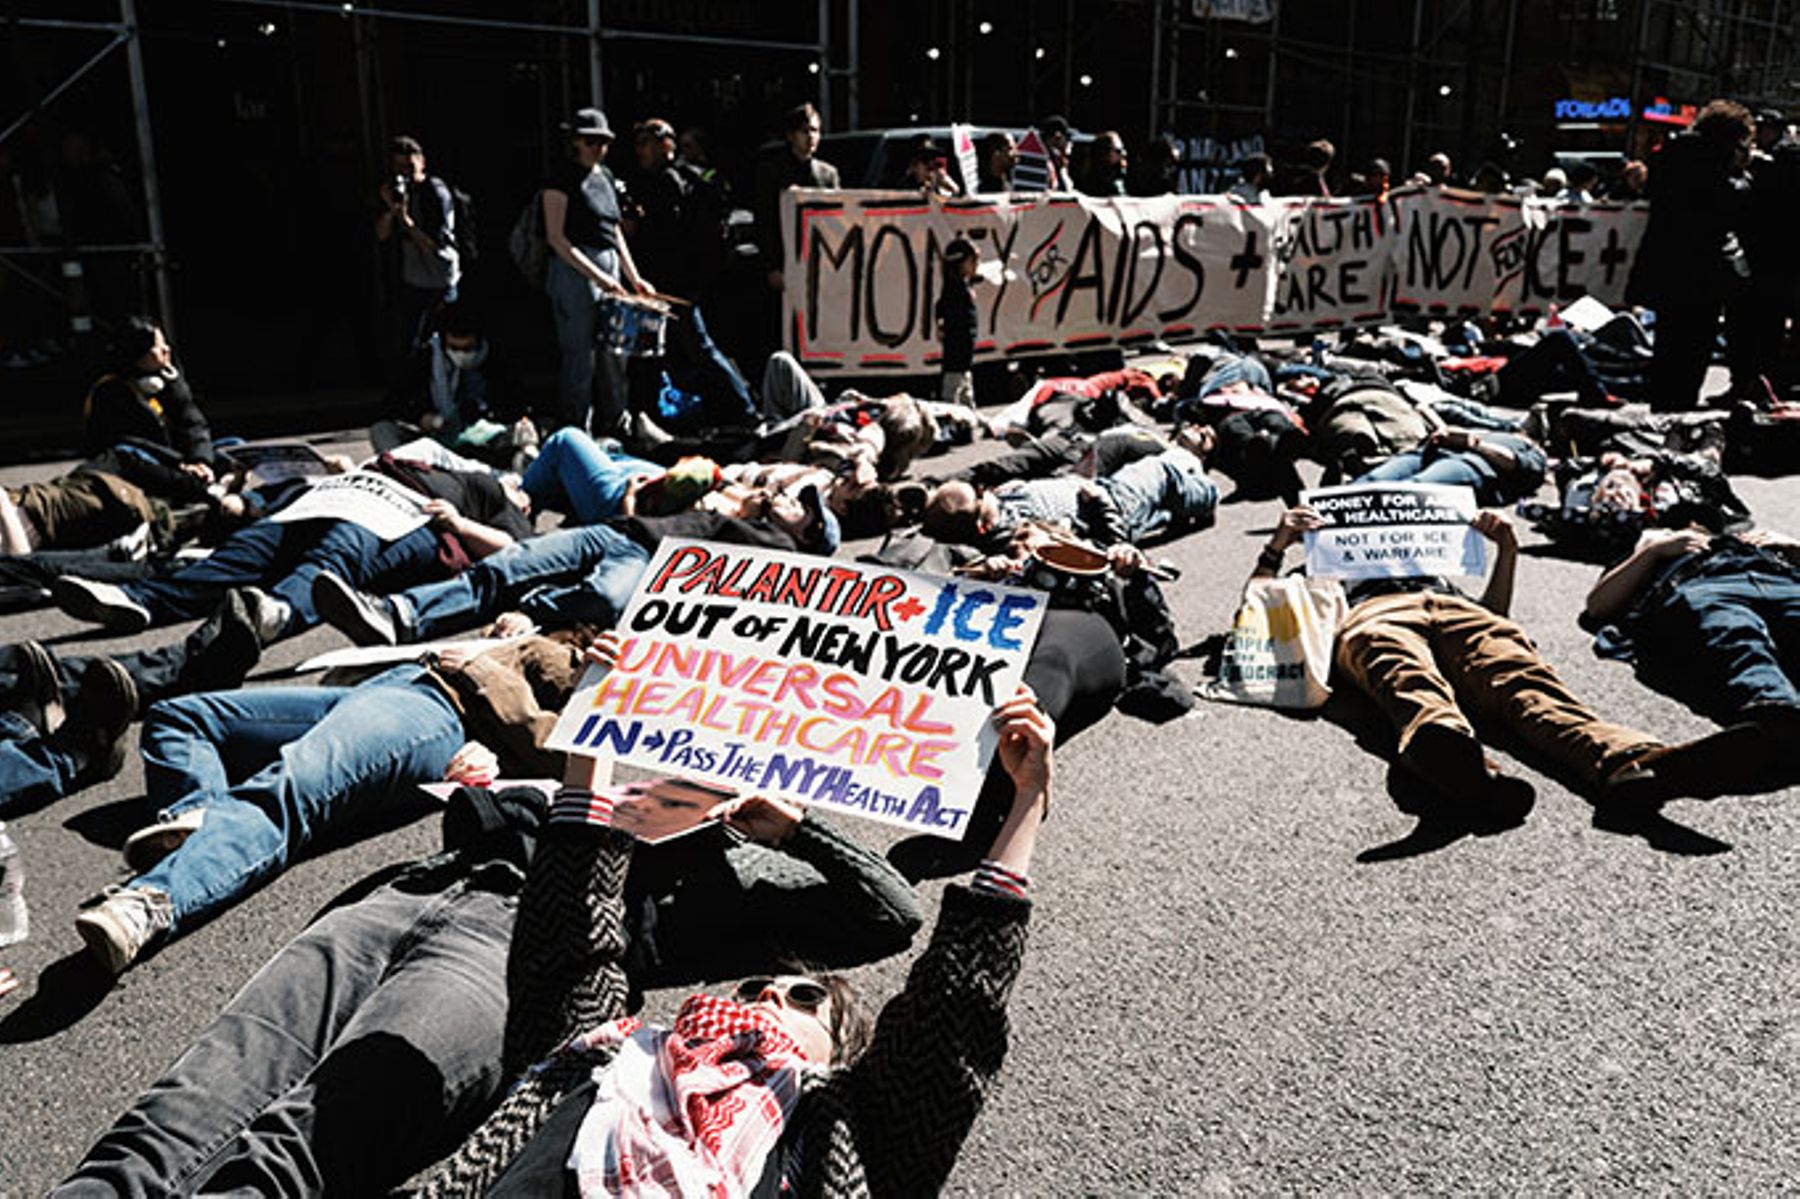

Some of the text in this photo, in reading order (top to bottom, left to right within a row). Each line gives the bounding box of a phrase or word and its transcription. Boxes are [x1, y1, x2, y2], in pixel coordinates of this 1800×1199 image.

[807, 222, 1019, 347] MONY
[1030, 244, 1068, 296] FOR
[1055, 213, 1204, 329] AIDS
[1275, 208, 1373, 263] ALTH
[1406, 209, 1500, 291] NOT
[1520, 217, 1592, 303] ICE
[1313, 495, 1374, 511] MONEY
[1382, 493, 1418, 508] FOR
[1334, 531, 1451, 547] NOT FOR ICE
[1345, 508, 1459, 524] HEALTHCARE
[646, 545, 908, 631] PALANTIR
[923, 582, 1037, 652] ICE
[1363, 547, 1448, 562] WARFARE
[616, 637, 957, 736] UNIVERSAL
[631, 600, 1009, 702] OUT OF NEW YORK
[572, 714, 643, 756] IN
[658, 728, 719, 772] PASS
[716, 742, 764, 783] THE
[906, 784, 968, 830] ACT
[594, 676, 960, 785] HEALTHCARE
